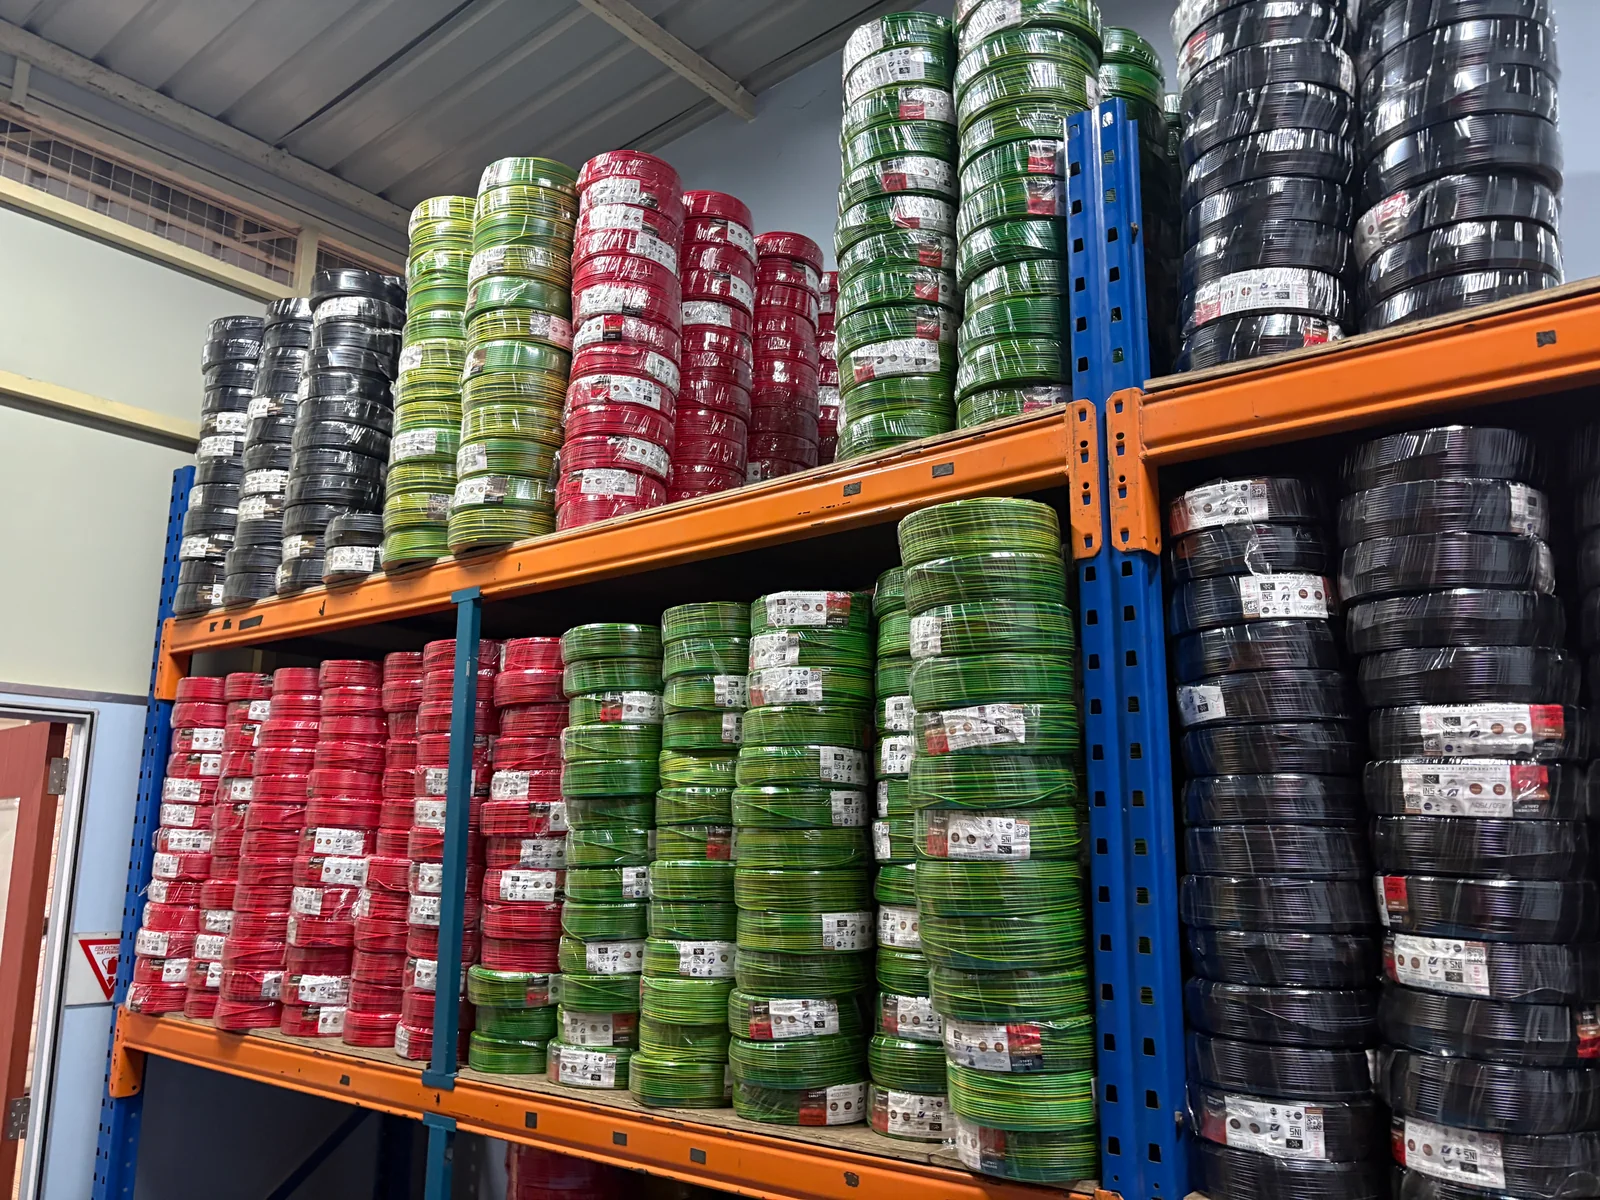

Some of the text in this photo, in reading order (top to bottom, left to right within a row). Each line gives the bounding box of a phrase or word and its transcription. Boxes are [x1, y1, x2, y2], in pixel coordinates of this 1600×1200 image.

[1469, 801, 1506, 810] 450/750V
[1450, 960, 1463, 969] SNI
[1289, 1126, 1302, 1137] SNI
[1464, 1151, 1478, 1161] SNI
